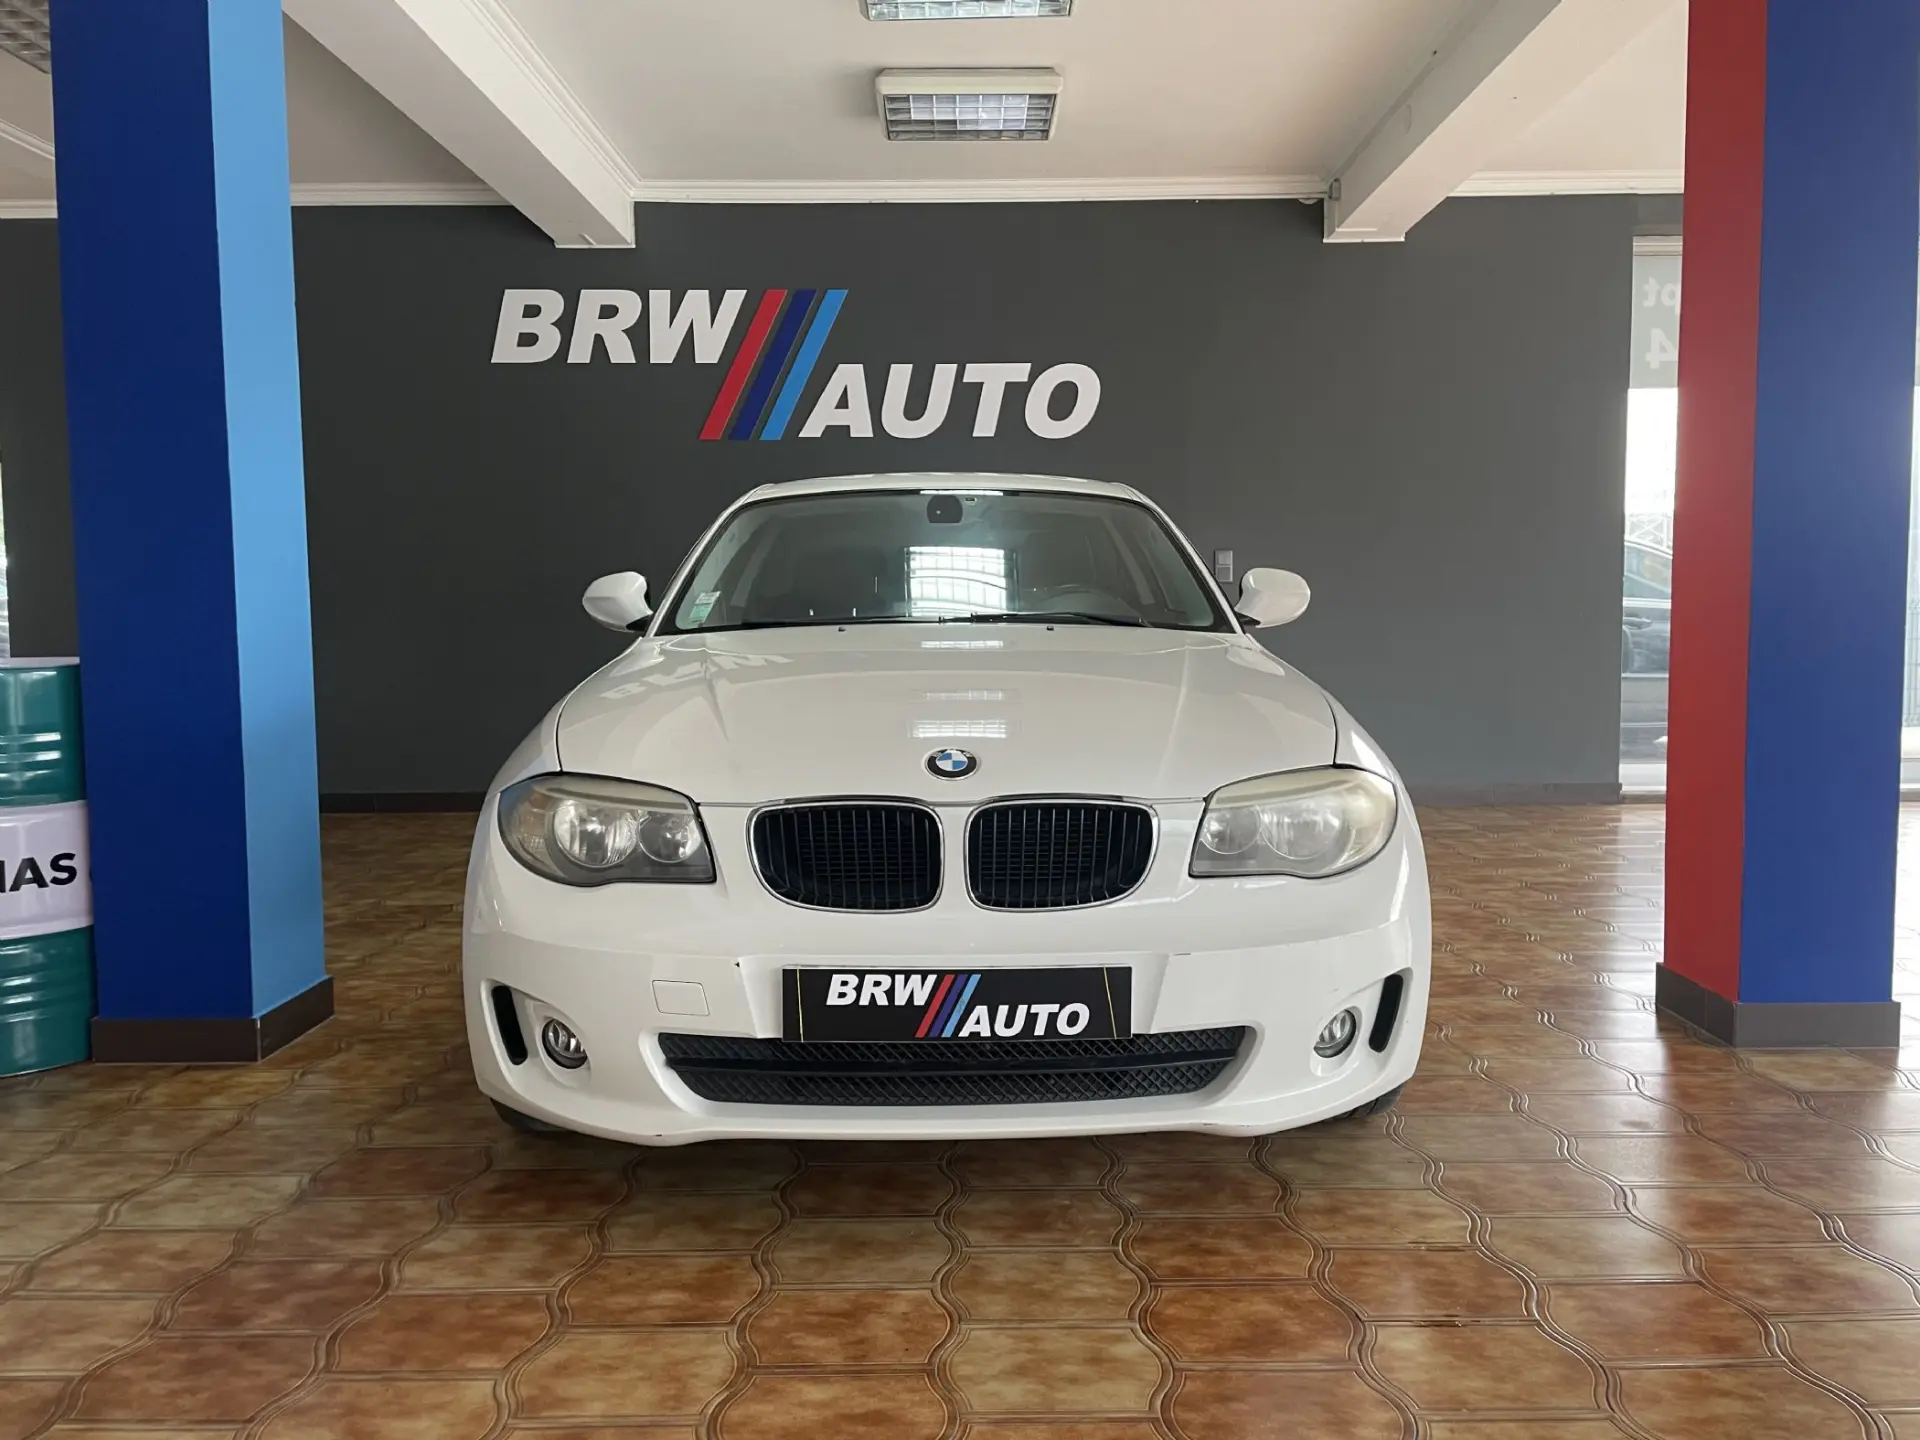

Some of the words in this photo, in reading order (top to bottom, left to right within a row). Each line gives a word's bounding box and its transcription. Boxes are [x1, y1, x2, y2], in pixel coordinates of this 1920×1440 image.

[490, 288, 748, 364] BRW
[798, 363, 1101, 439] AUTO
[0, 852, 77, 894] AS
[826, 974, 938, 1006] BRW
[958, 1002, 1090, 1037] AUTO
